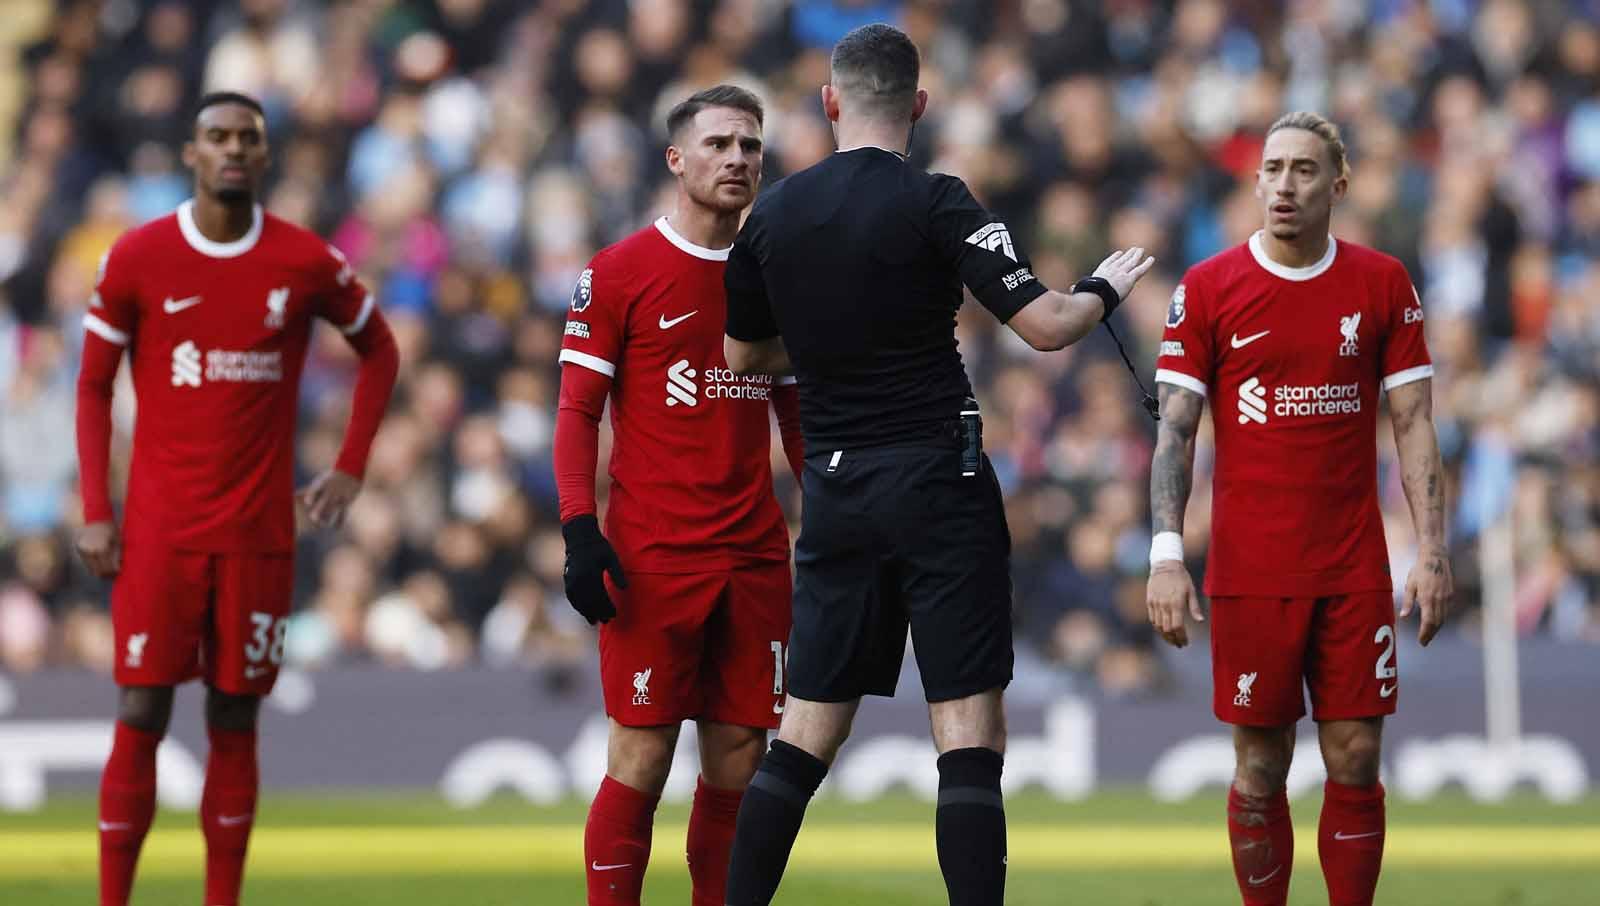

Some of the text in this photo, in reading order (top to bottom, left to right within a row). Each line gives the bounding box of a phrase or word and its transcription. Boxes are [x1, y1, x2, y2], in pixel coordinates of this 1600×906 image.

[1274, 382, 1359, 401] standard
[1274, 396, 1361, 417] chartered
[244, 611, 287, 665] 38
[632, 696, 651, 705] LFC
